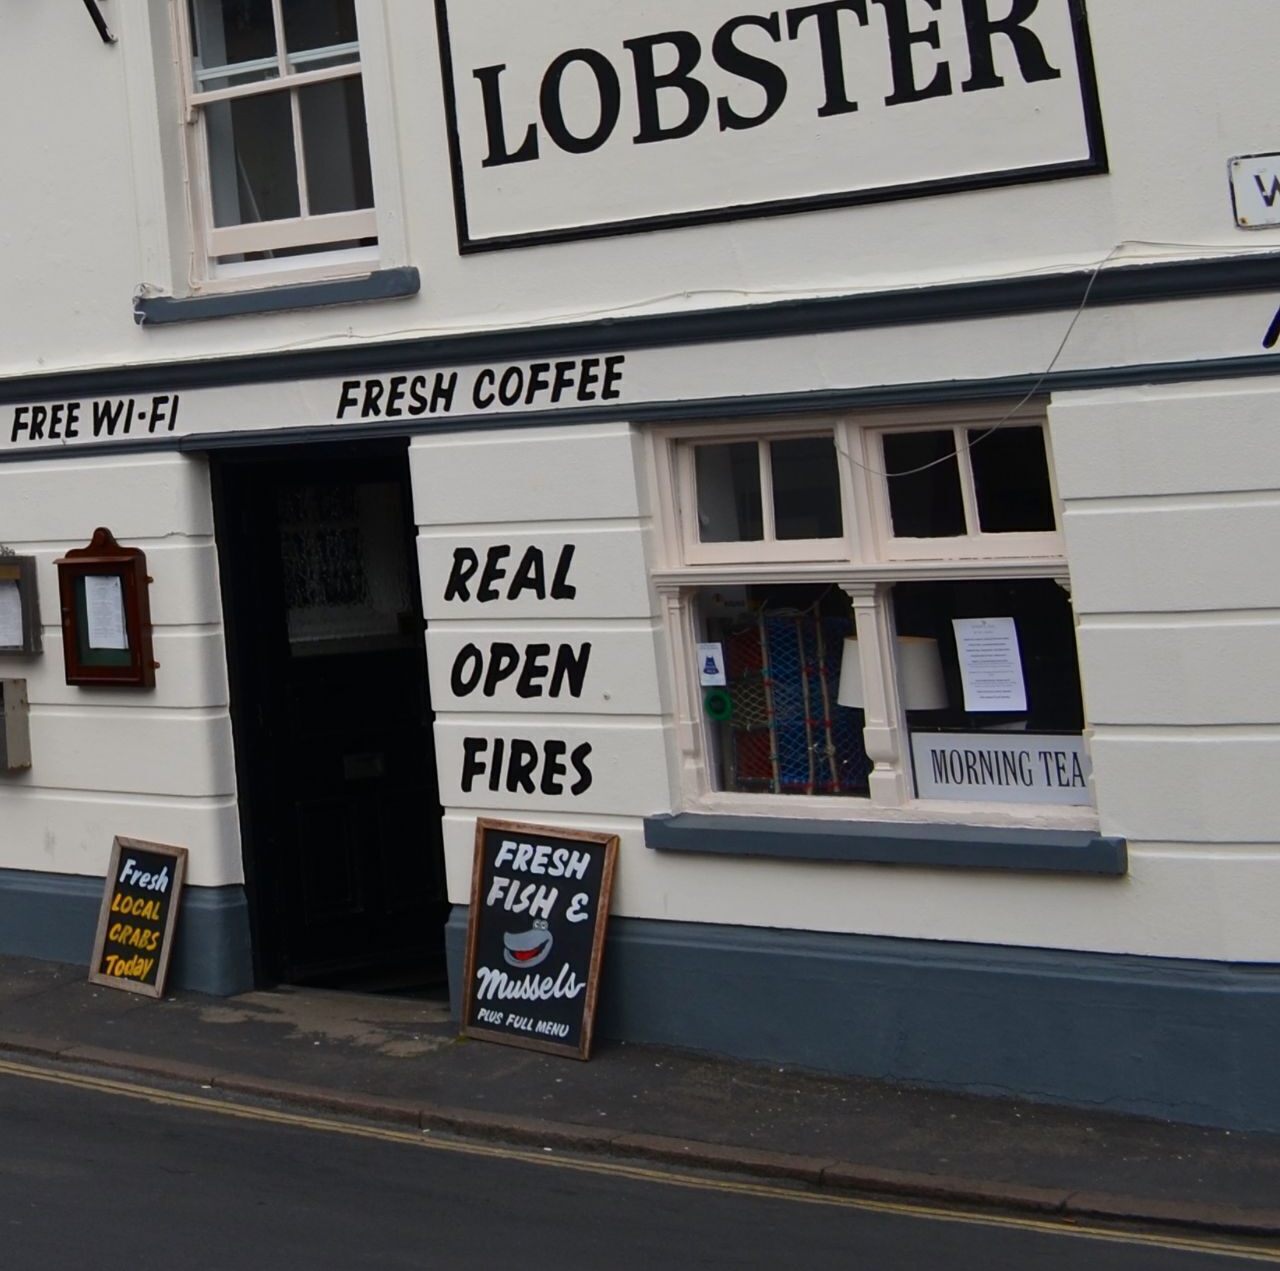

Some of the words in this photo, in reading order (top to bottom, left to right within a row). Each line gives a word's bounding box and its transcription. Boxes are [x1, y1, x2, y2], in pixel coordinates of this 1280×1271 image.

[337, 373, 458, 419] FRESH
[472, 355, 625, 408] COFFEE
[11, 402, 80, 442] FREE
[444, 544, 576, 603] REAL
[450, 642, 592, 698] OPEN
[461, 737, 592, 796] FIRES
[931, 749, 1033, 787] MORNING
[119, 858, 169, 893] Fresh
[494, 840, 591, 880] FRESH
[111, 893, 161, 921] LOCAL
[486, 876, 559, 919] FISH
[565, 892, 589, 923] &
[109, 922, 160, 951] CRABS
[106, 954, 154, 980] Today
[476, 962, 586, 1001] Mussels
[477, 1007, 504, 1025] PLUS
[505, 1013, 533, 1031] FULL
[535, 1019, 569, 1037] MENU
